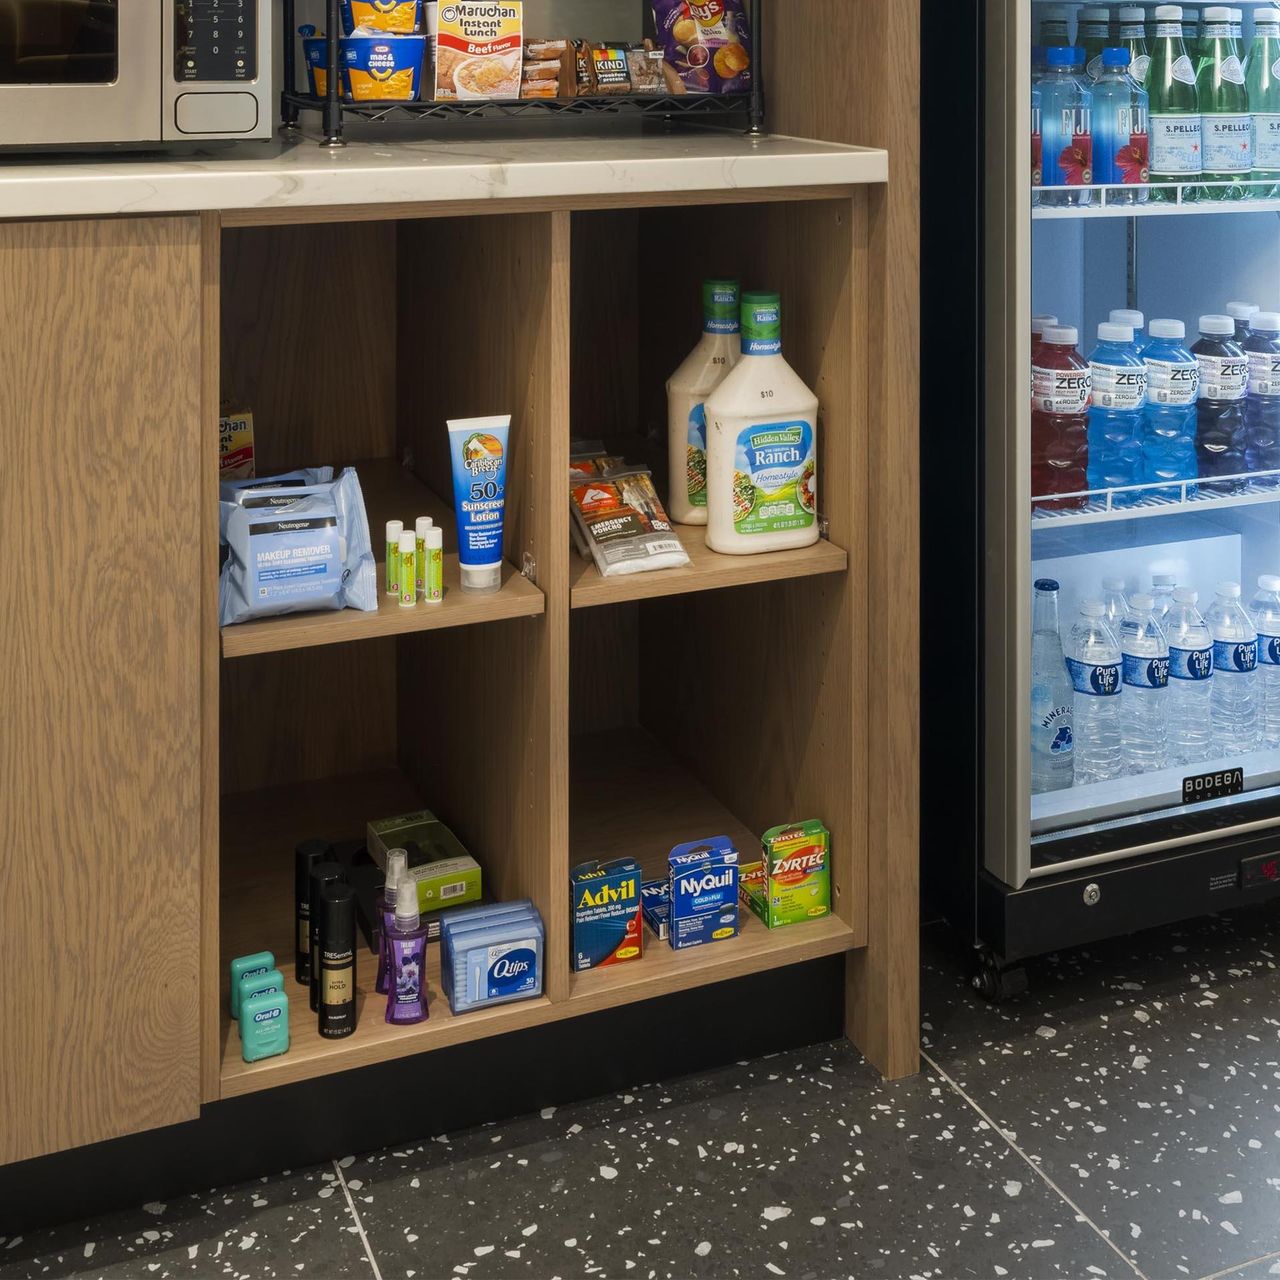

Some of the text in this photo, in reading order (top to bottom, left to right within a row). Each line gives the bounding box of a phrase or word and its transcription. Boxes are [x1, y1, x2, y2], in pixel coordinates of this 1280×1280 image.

[456, 5, 516, 17] Maruchan
[459, 19, 502, 28] Instant
[464, 28, 497, 36] Lunch
[467, 42, 511, 54] Beef Flavor
[596, 60, 624, 70] KIND
[1061, 109, 1091, 135] FIJI
[1118, 109, 1148, 135] FIJI
[757, 314, 776, 322] Ranch
[1056, 376, 1091, 389] ZERO
[754, 433, 799, 445] Hidden Valley
[755, 449, 799, 465] Ranch
[464, 459, 502, 470] Caribbean
[756, 470, 798, 482] Homestyle
[470, 482, 504, 501] 50+
[462, 501, 504, 511] Sunscreen
[471, 512, 499, 522] Lotion
[278, 522, 310, 530] Neutrogena
[590, 516, 632, 530] EMERGENCY
[592, 524, 622, 535] PONCHO
[257, 551, 291, 561] MAKEUP
[292, 545, 331, 556] REMOVER
[1238, 644, 1255, 654] Pure
[1193, 652, 1210, 662] Pure
[1240, 652, 1254, 662] Life
[1152, 660, 1169, 670] Pure
[1195, 658, 1208, 670] Life
[1096, 666, 1116, 677] Pure
[1154, 667, 1168, 678] Life
[1098, 674, 1114, 685] Life
[1186, 771, 1242, 792] BODEGA
[676, 852, 710, 864] NyQuil
[771, 852, 825, 874] ZYRTEC
[578, 870, 606, 880] Advil
[680, 869, 733, 896] NyQuil
[577, 879, 635, 909] Advil
[256, 1010, 279, 1021] Oral-B
